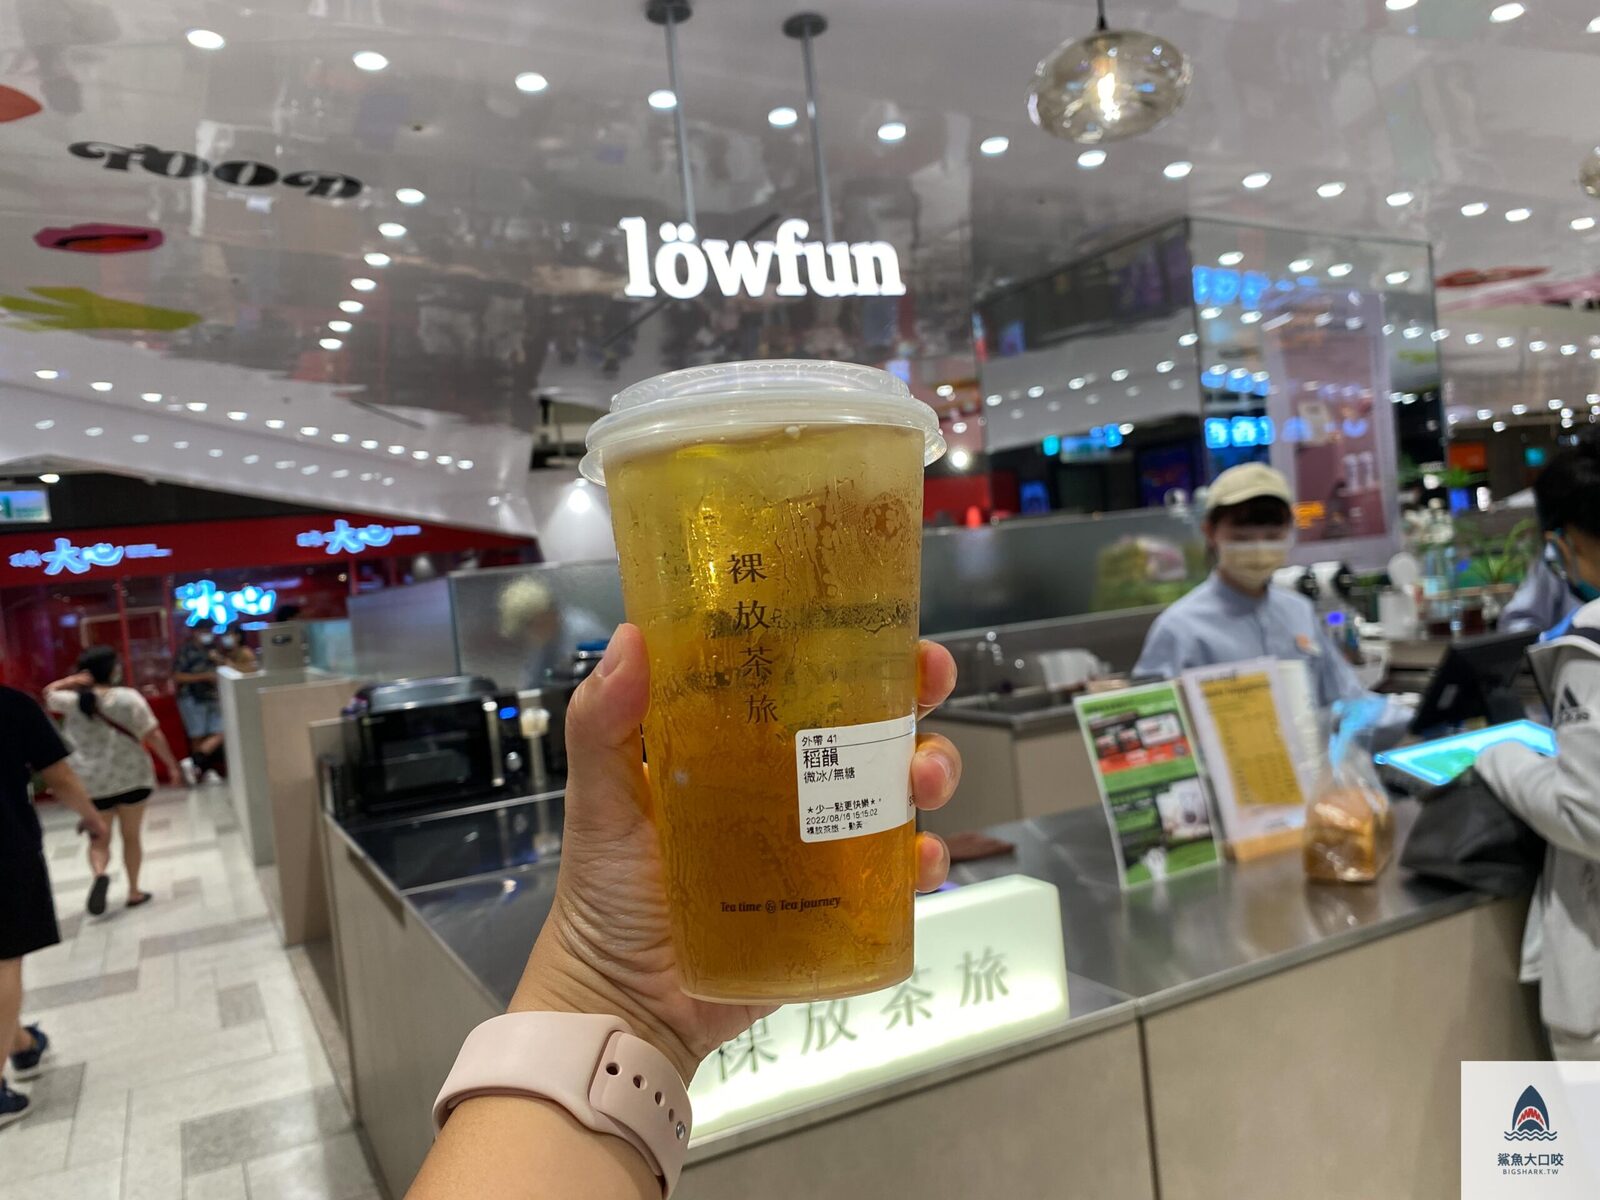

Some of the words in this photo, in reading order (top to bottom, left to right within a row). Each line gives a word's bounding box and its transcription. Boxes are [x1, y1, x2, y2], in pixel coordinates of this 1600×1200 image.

[617, 216, 906, 299] löwfun
[727, 553, 779, 724] 裸放茶旅
[801, 735, 823, 747] 外帶
[827, 734, 837, 744] 41
[803, 748, 839, 769] 稻韻
[803, 767, 855, 784] 微冰/無糖
[720, 902, 736, 912] Tea
[738, 902, 762, 912] time
[780, 899, 798, 911] Tea
[798, 896, 842, 912] journey
